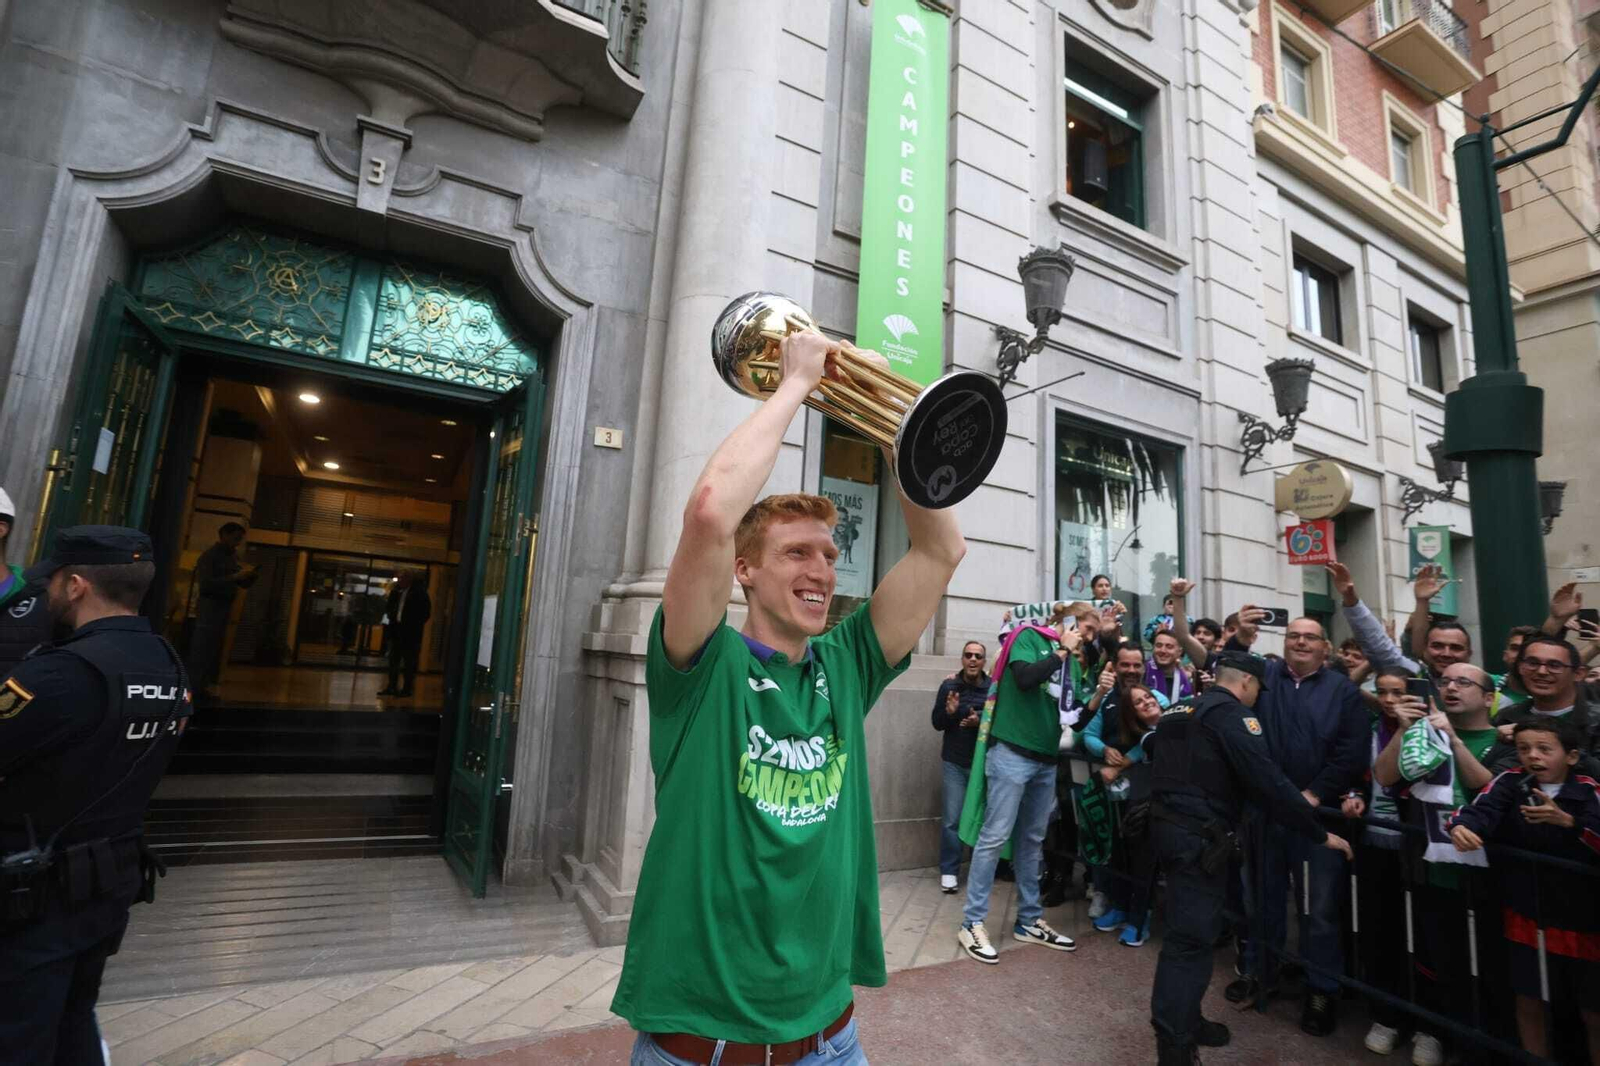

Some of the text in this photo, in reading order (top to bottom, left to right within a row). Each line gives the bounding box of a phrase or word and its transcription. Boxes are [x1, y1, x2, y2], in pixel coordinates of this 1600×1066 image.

[367, 156, 386, 185] 3
[897, 67, 918, 297] CAMPEONES
[605, 431, 612, 444] 3
[953, 440, 973, 457] acb
